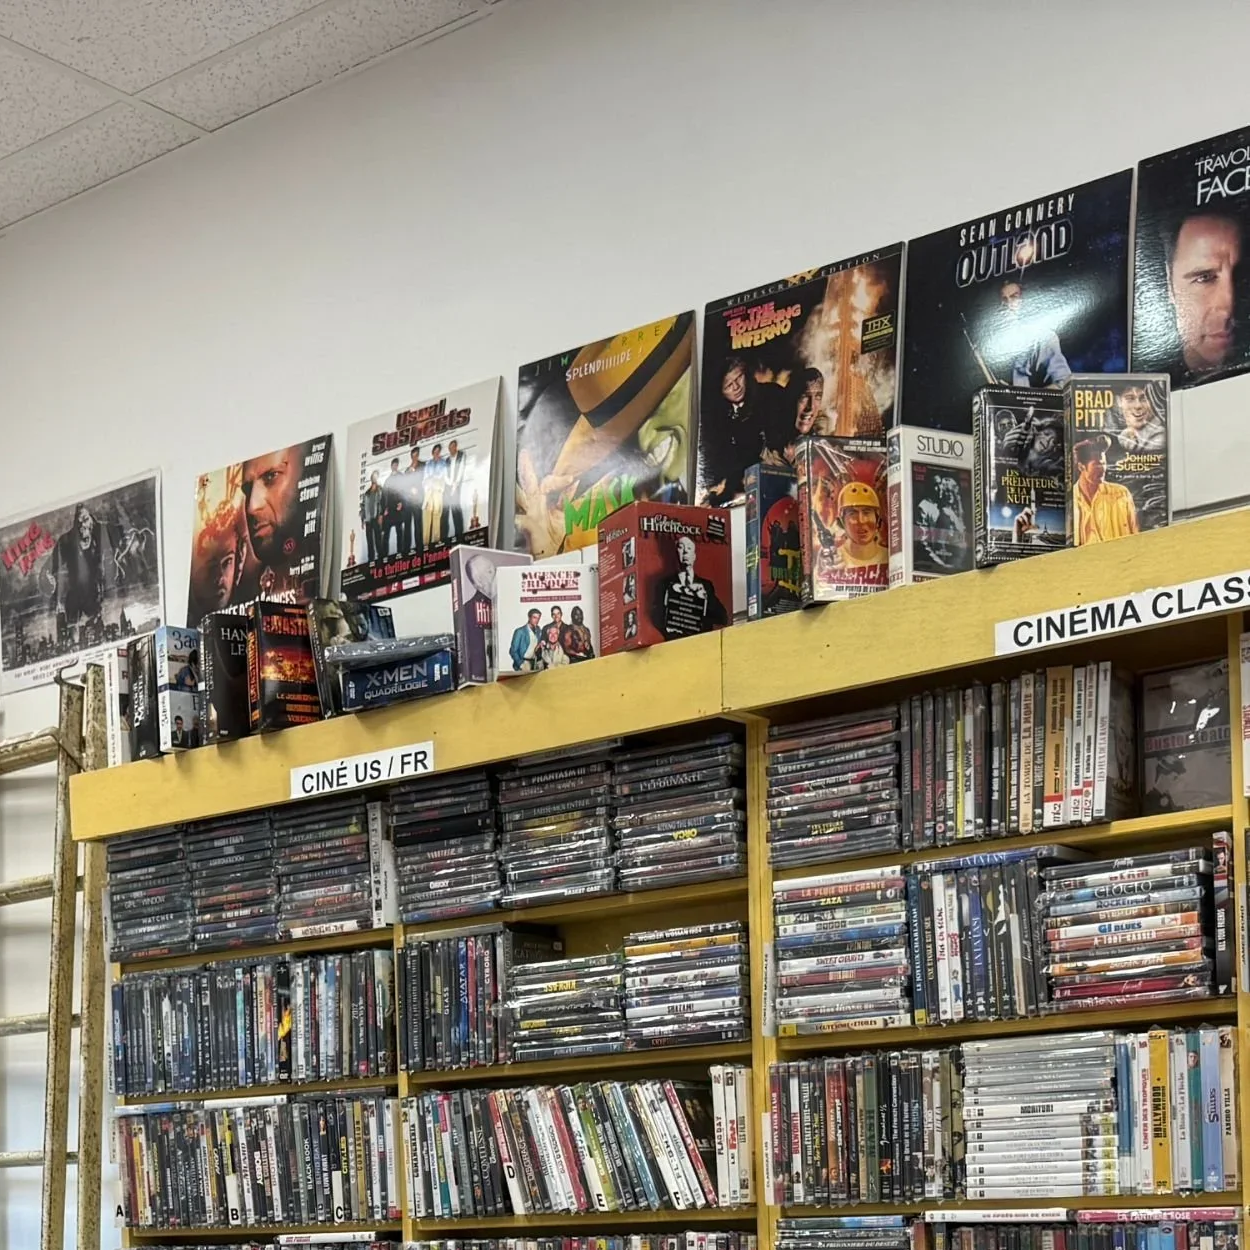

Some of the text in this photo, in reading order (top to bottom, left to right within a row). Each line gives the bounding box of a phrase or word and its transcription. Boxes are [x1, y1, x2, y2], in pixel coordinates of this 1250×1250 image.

[959, 192, 1076, 247] SEAN CONNERY
[726, 252, 881, 308] WIDESCR EDITION
[746, 301, 775, 316] THE
[727, 304, 802, 338] TOWERING
[865, 314, 892, 333] THX
[731, 318, 793, 350] INFERNO
[1074, 389, 1114, 409] BRAD
[396, 397, 448, 432] Usual
[1075, 408, 1106, 428] PITT
[371, 406, 472, 457] Suspects
[311, 441, 327, 454] bruce
[917, 434, 964, 458] STUDIO
[304, 451, 325, 467] willis
[1115, 460, 1152, 472] SUEDE
[1123, 451, 1163, 463] JOHNNY
[299, 486, 320, 503] stowe
[1006, 493, 1031, 505] NUIT
[305, 508, 318, 521] brad
[563, 476, 638, 536] MASK
[303, 519, 317, 537] pitt
[642, 516, 703, 537] HITCHCOCK
[411, 556, 423, 568] de
[1013, 599, 1142, 648] CINÉMA
[365, 661, 428, 689] X-MEN
[364, 680, 429, 700] QUADRILOGIE
[301, 749, 429, 794] CINÉ US / FR
[820, 896, 843, 906] ZAZA
[1098, 922, 1142, 934] GI BLUES
[1152, 1085, 1162, 1139] HOLLYWOOD
[1223, 1087, 1232, 1136] PANCHO VILLA
[791, 1111, 800, 1155] BULWORTH
[506, 1164, 516, 1180] D
[114, 1204, 125, 1219] A
